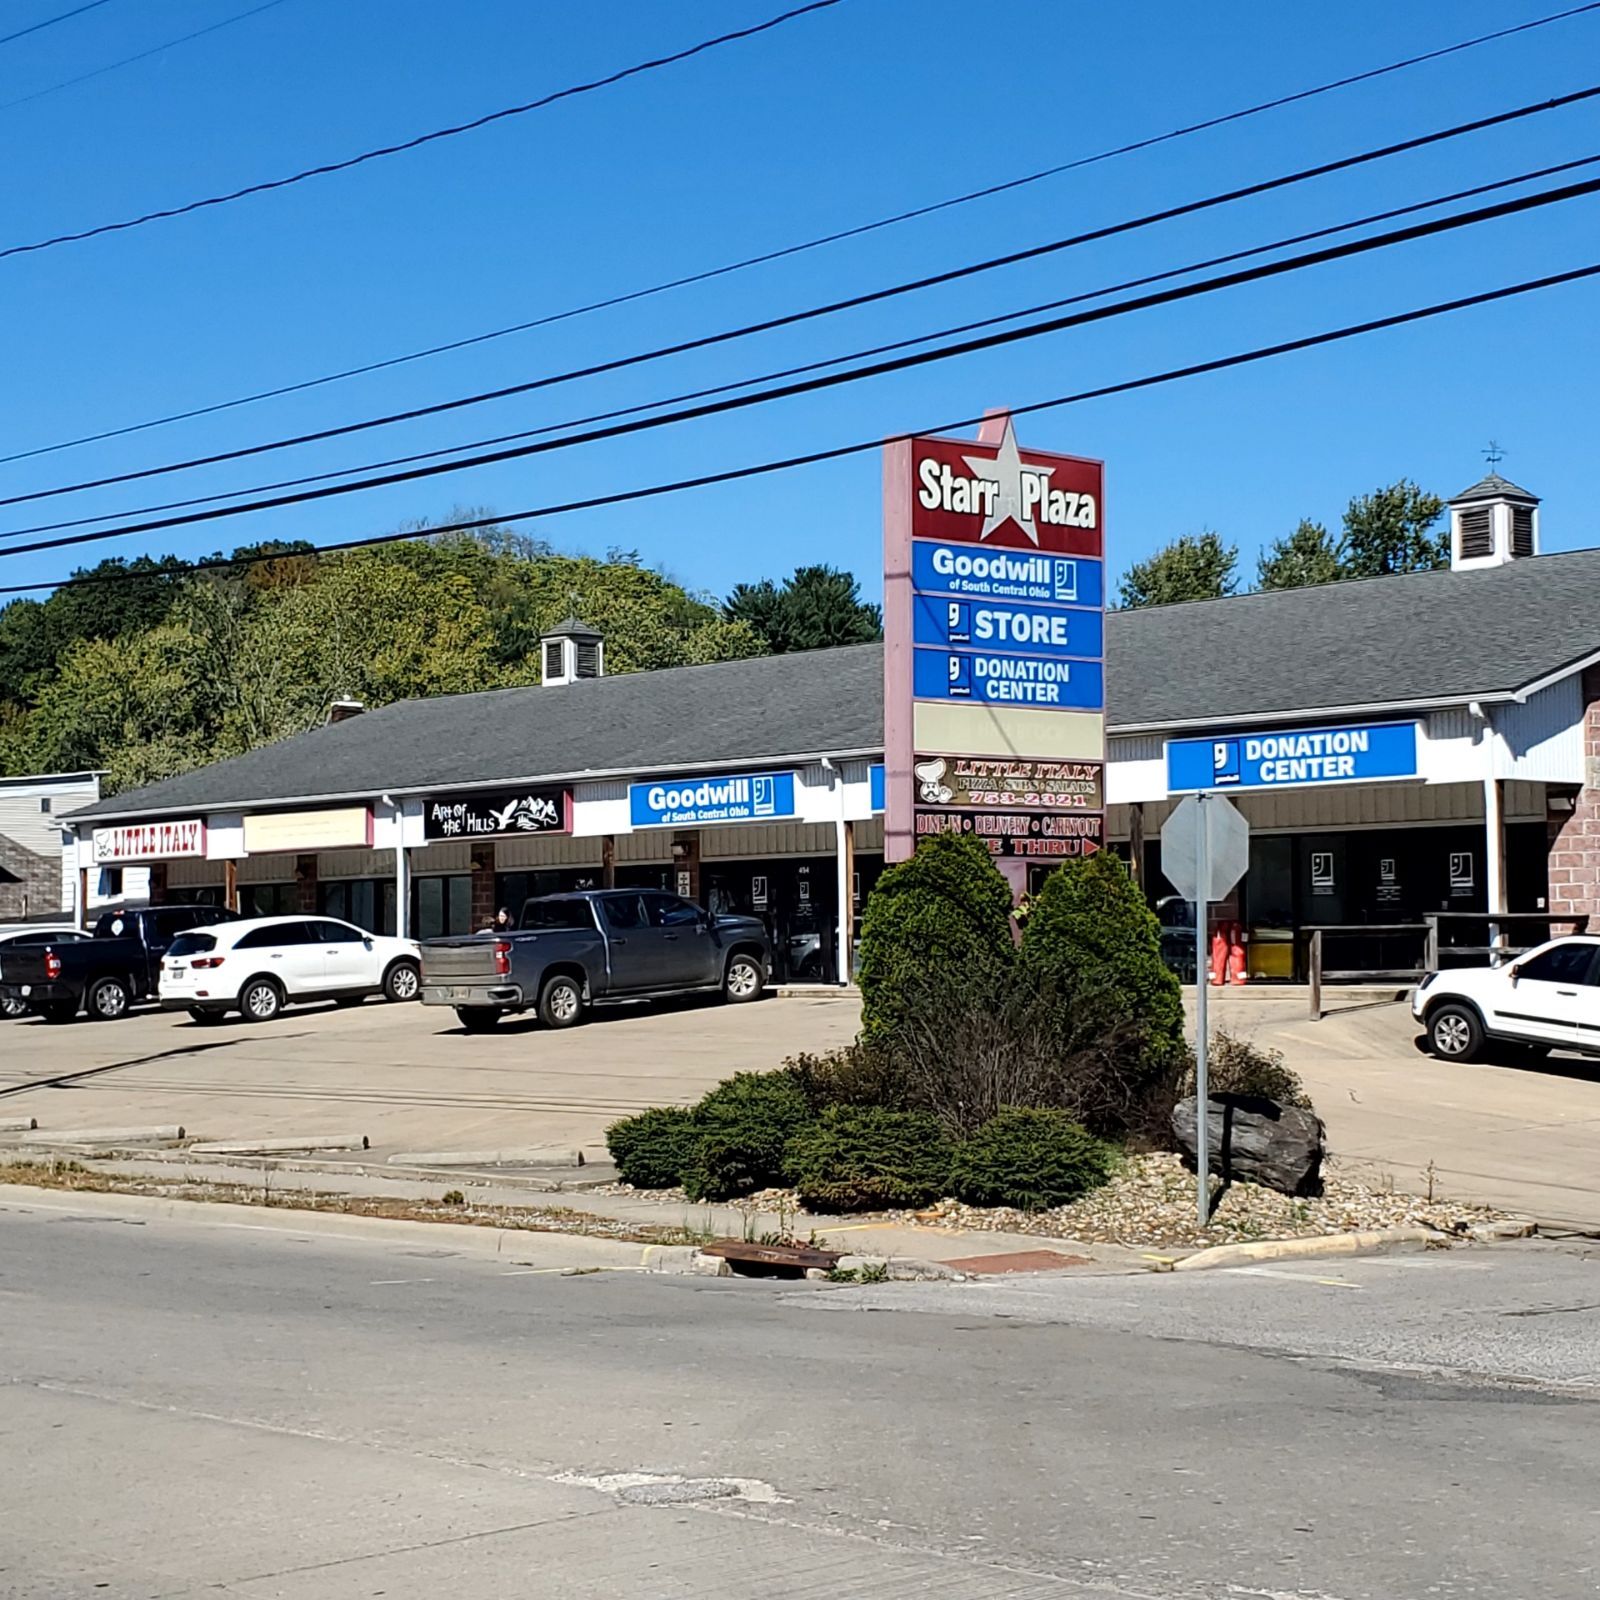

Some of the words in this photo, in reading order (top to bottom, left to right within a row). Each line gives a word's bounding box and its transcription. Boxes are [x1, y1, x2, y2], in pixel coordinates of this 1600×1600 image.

[918, 458, 999, 517] Starr
[1021, 471, 1096, 529] Plaza
[933, 549, 1050, 584] Goodwill
[949, 578, 960, 589] of
[962, 580, 990, 593] South
[992, 583, 1027, 596] Central
[1029, 586, 1050, 598] Ohio
[975, 610, 1068, 645] STORE
[975, 658, 1069, 683] DONATION
[986, 679, 1059, 702] CENTER
[1246, 731, 1368, 760] DONATION
[954, 761, 1032, 778] LITTLE
[1035, 764, 1100, 780] ITALY
[1260, 755, 1355, 781] CENTER
[648, 779, 749, 810] Goodwill
[959, 778, 998, 790] PIZZA
[1004, 779, 1039, 792] SUBS
[1046, 781, 1096, 794] SALADS
[969, 791, 1087, 807] 753-2321
[662, 813, 670, 823] of
[672, 811, 696, 822] South
[697, 807, 727, 820] Central
[729, 805, 749, 817] Ohio
[916, 814, 962, 834] DINE-IN
[974, 815, 1031, 836] DELIVERY
[1041, 816, 1101, 837] CARRYOUT
[114, 827, 156, 856] LITTLE
[160, 823, 197, 853] ITALY
[1010, 838, 1080, 855] THRU
